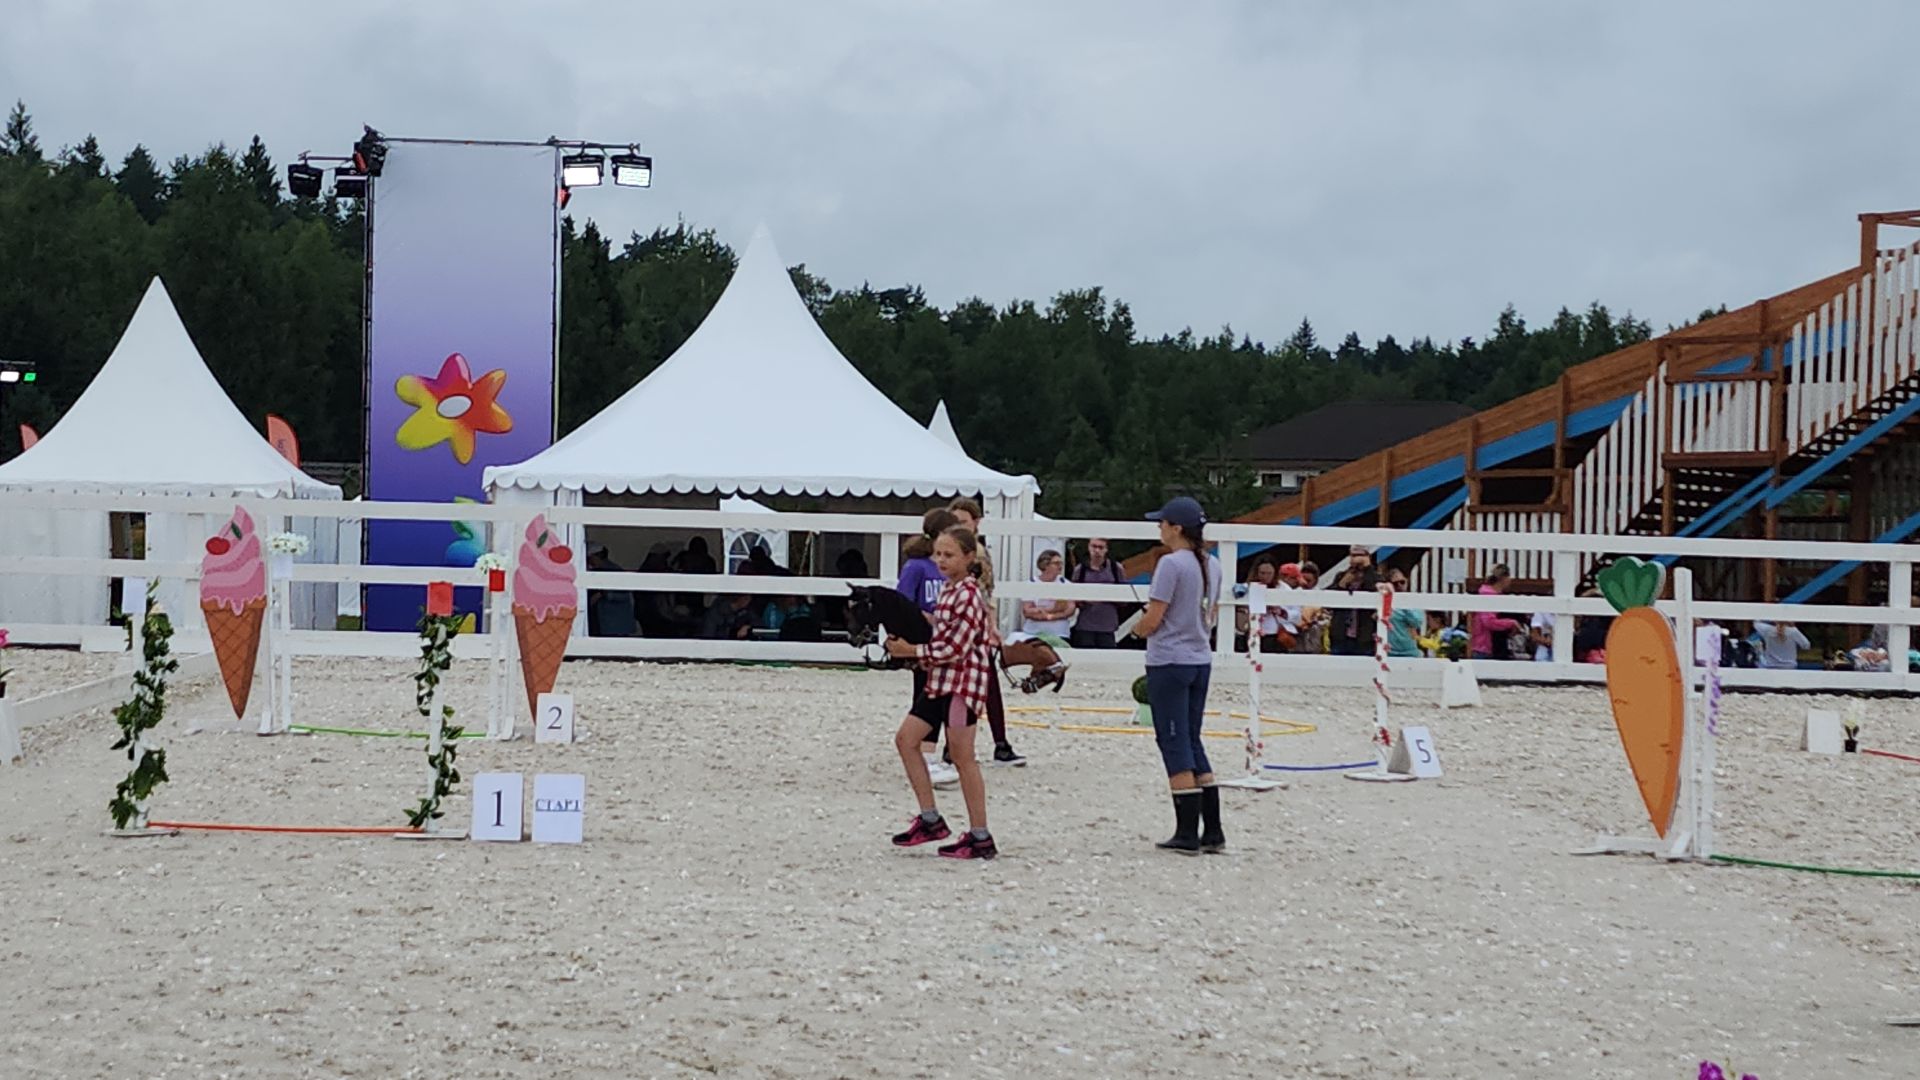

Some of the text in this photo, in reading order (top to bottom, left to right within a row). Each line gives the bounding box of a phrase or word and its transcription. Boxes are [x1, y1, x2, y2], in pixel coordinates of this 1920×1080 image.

[547, 706, 562, 730] 2
[1415, 739, 1432, 763] 5
[491, 790, 505, 827] 1
[535, 798, 581, 812] СТАРТ
